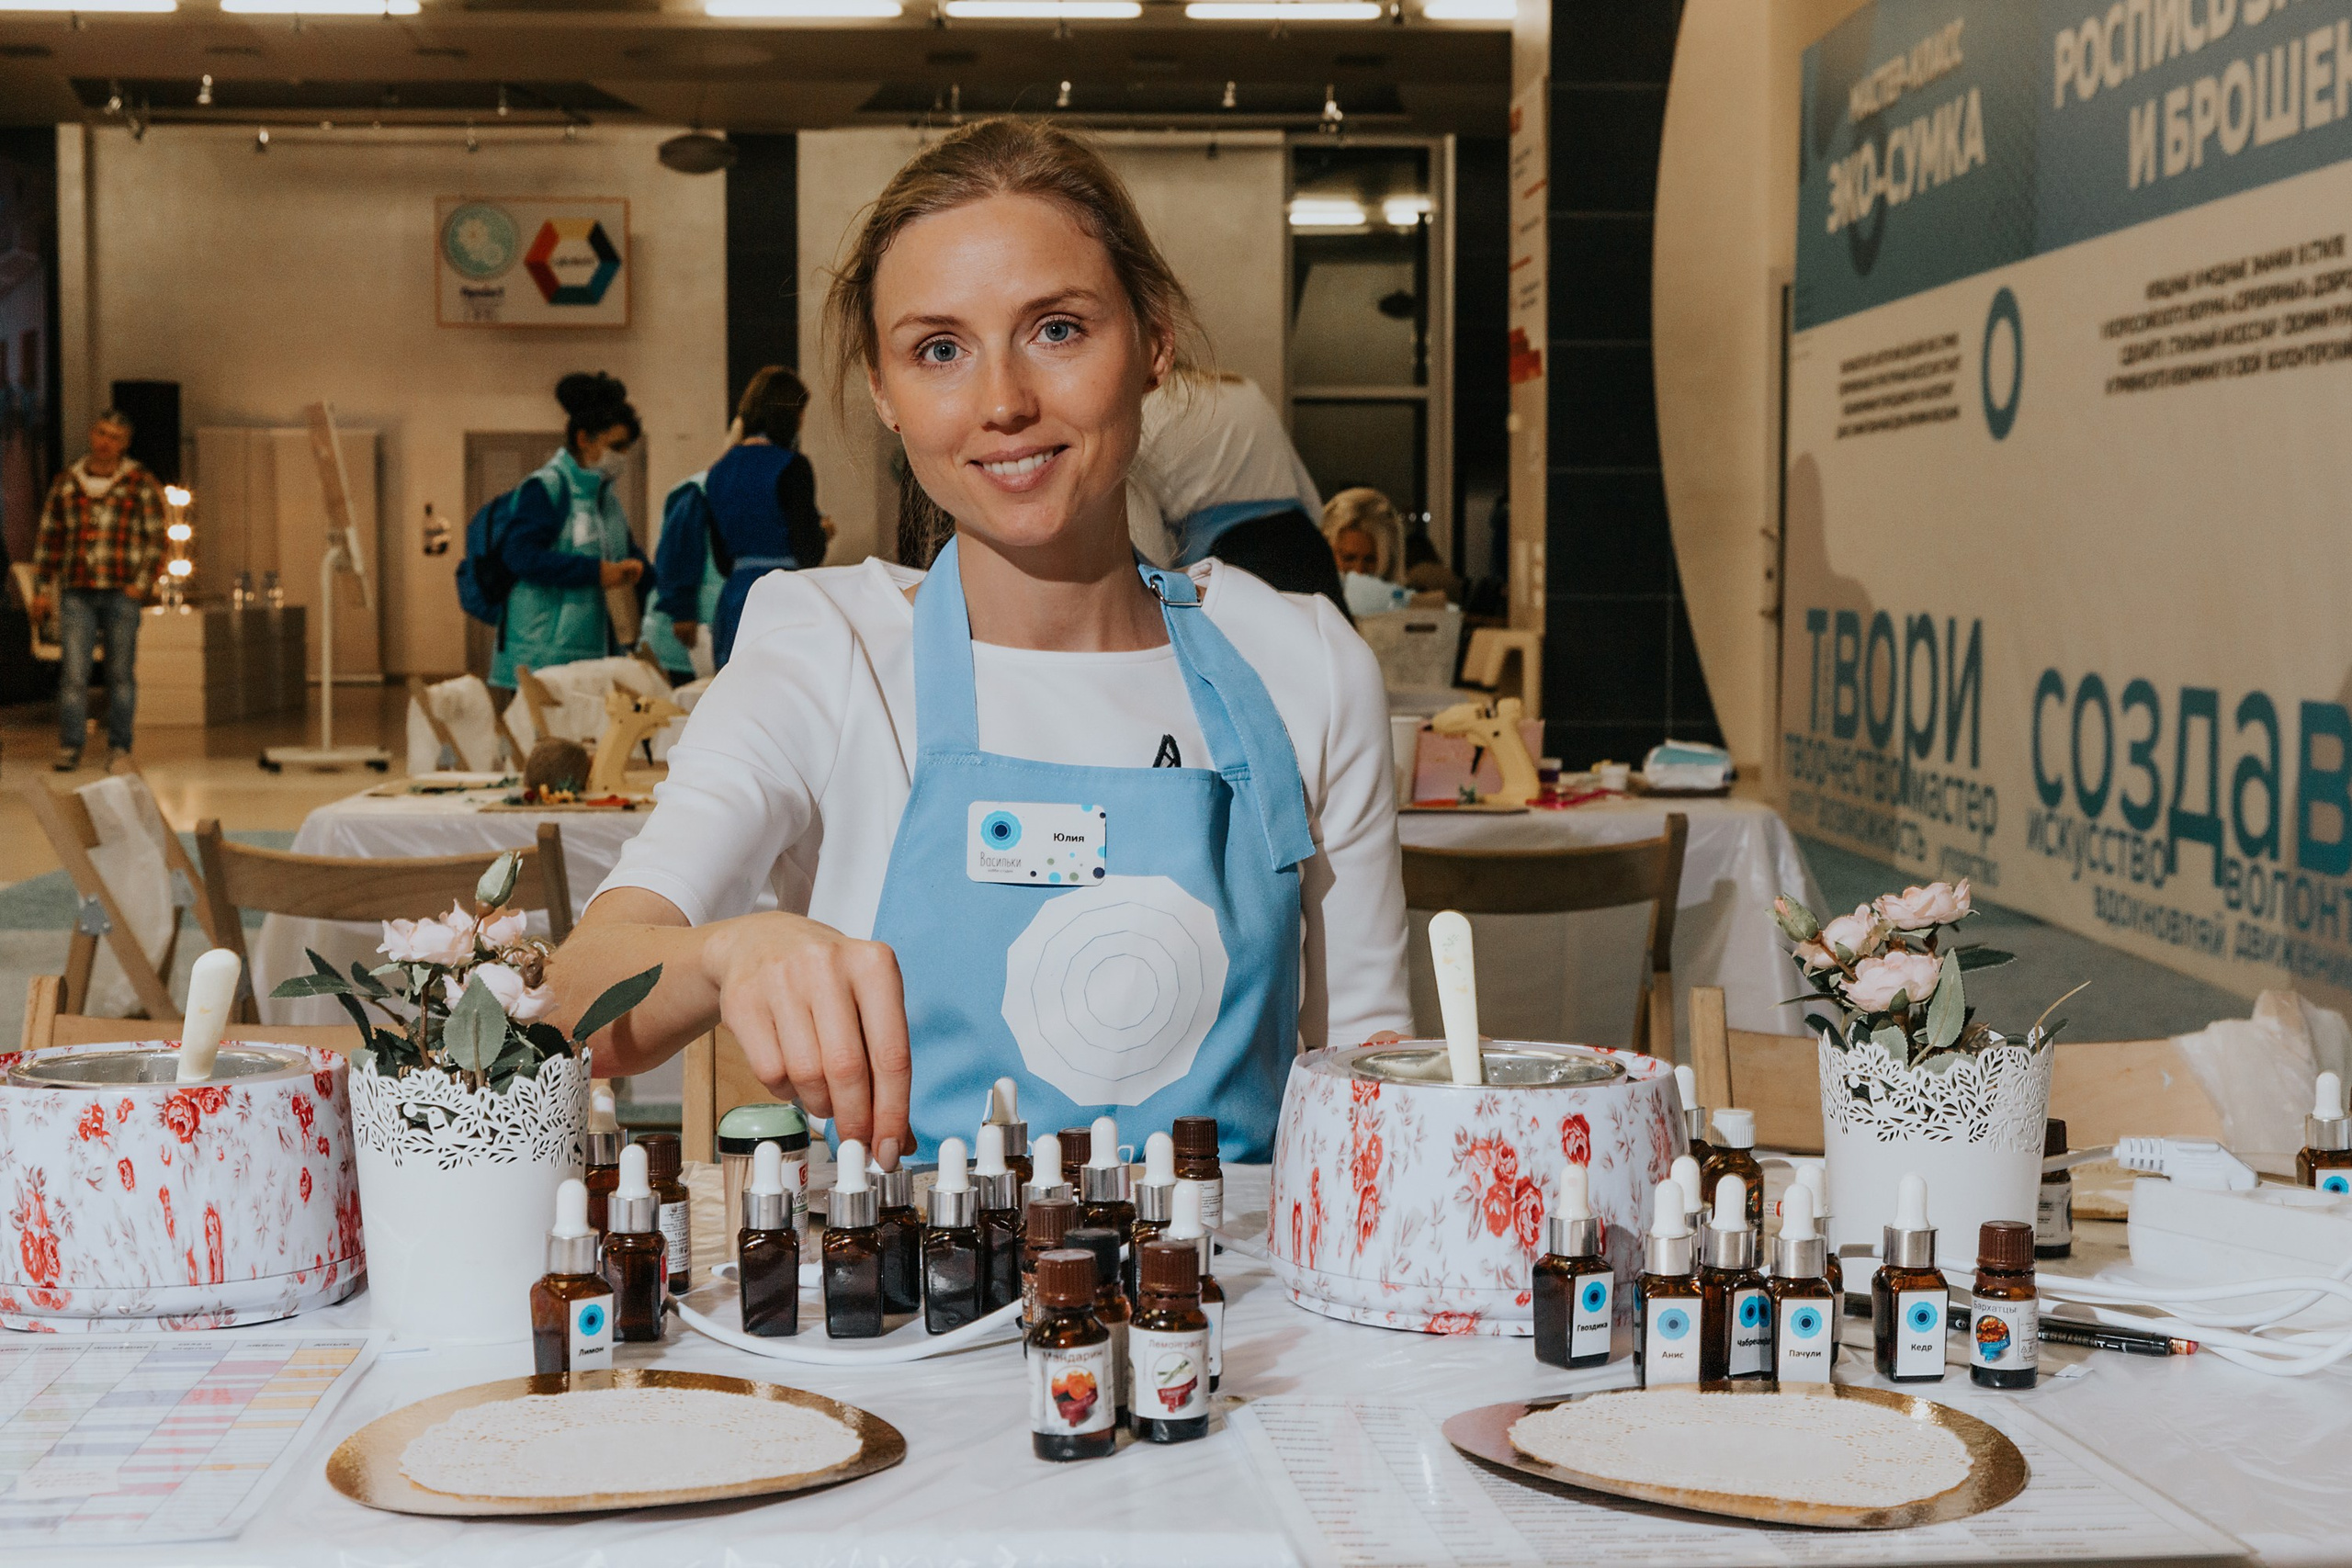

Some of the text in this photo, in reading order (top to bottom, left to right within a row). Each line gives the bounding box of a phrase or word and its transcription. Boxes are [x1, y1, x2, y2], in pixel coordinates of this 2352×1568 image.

[2127, 98, 2156, 191] И
[1826, 86, 1986, 234] ЭКО-СУМКА
[1053, 832, 1085, 843] Юлия
[2026, 807, 2168, 890] искусство
[979, 851, 1022, 867] Васильки
[1973, 1300, 2017, 1314] Бархатцы
[1577, 1321, 1608, 1332] Гвоздика
[578, 1346, 604, 1357] Лимон
[1911, 1343, 1933, 1353] Кедр
[1661, 1350, 1684, 1359] Анис
[1789, 1349, 1821, 1359] Пачули
